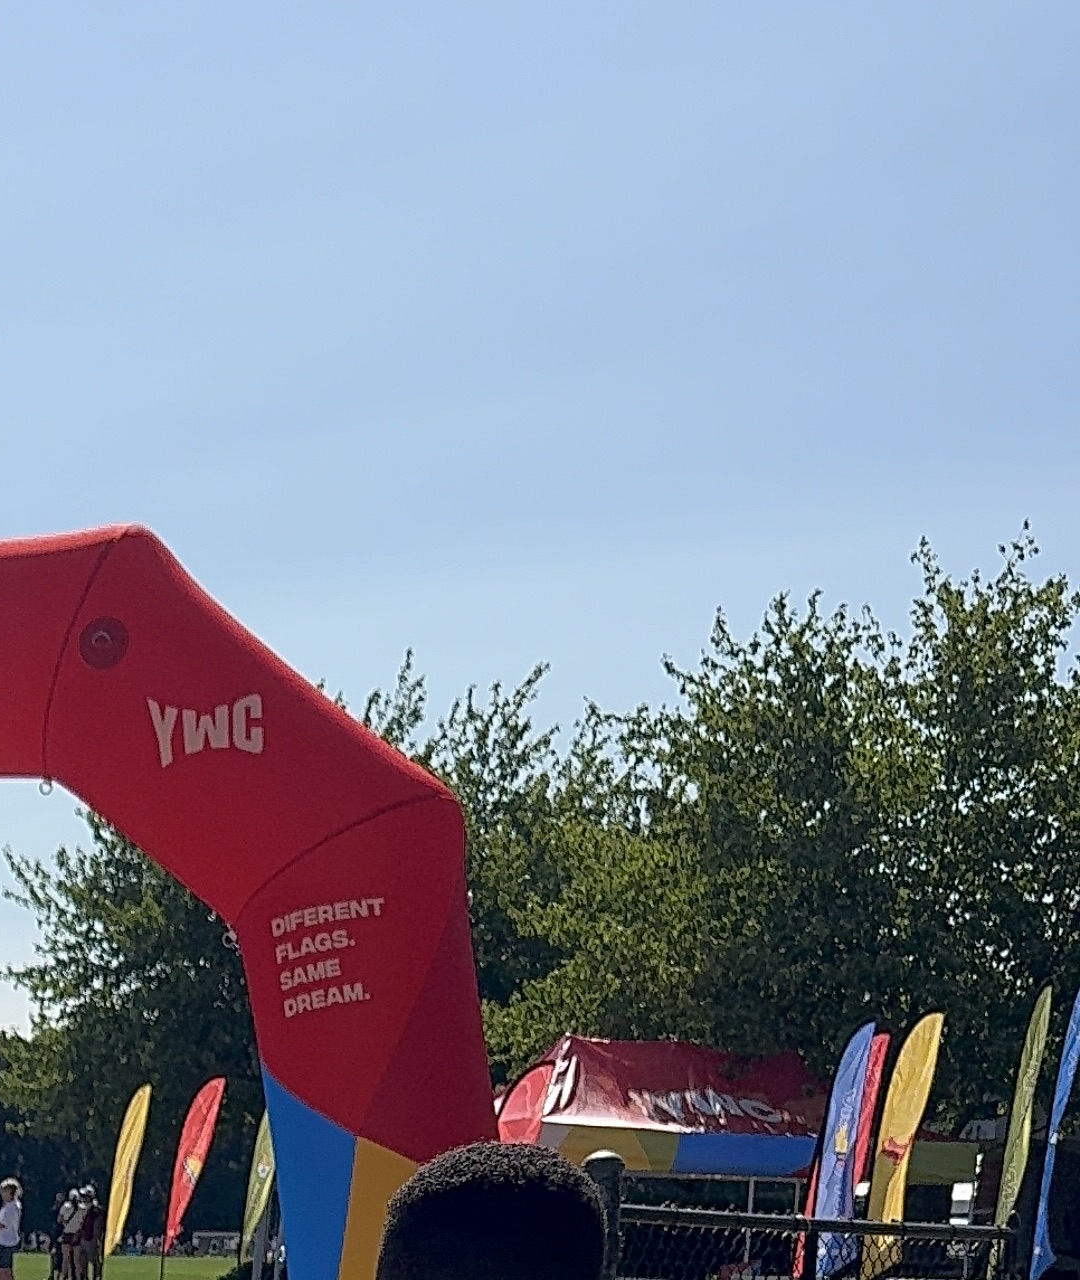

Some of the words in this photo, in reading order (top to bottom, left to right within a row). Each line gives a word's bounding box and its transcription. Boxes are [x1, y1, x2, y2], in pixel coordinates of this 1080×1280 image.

[146, 692, 264, 768] YWC
[271, 897, 385, 938] DIFERENT
[275, 929, 356, 964] FLAGS.
[280, 958, 341, 991] SAME
[283, 983, 371, 1018] DREAM.
